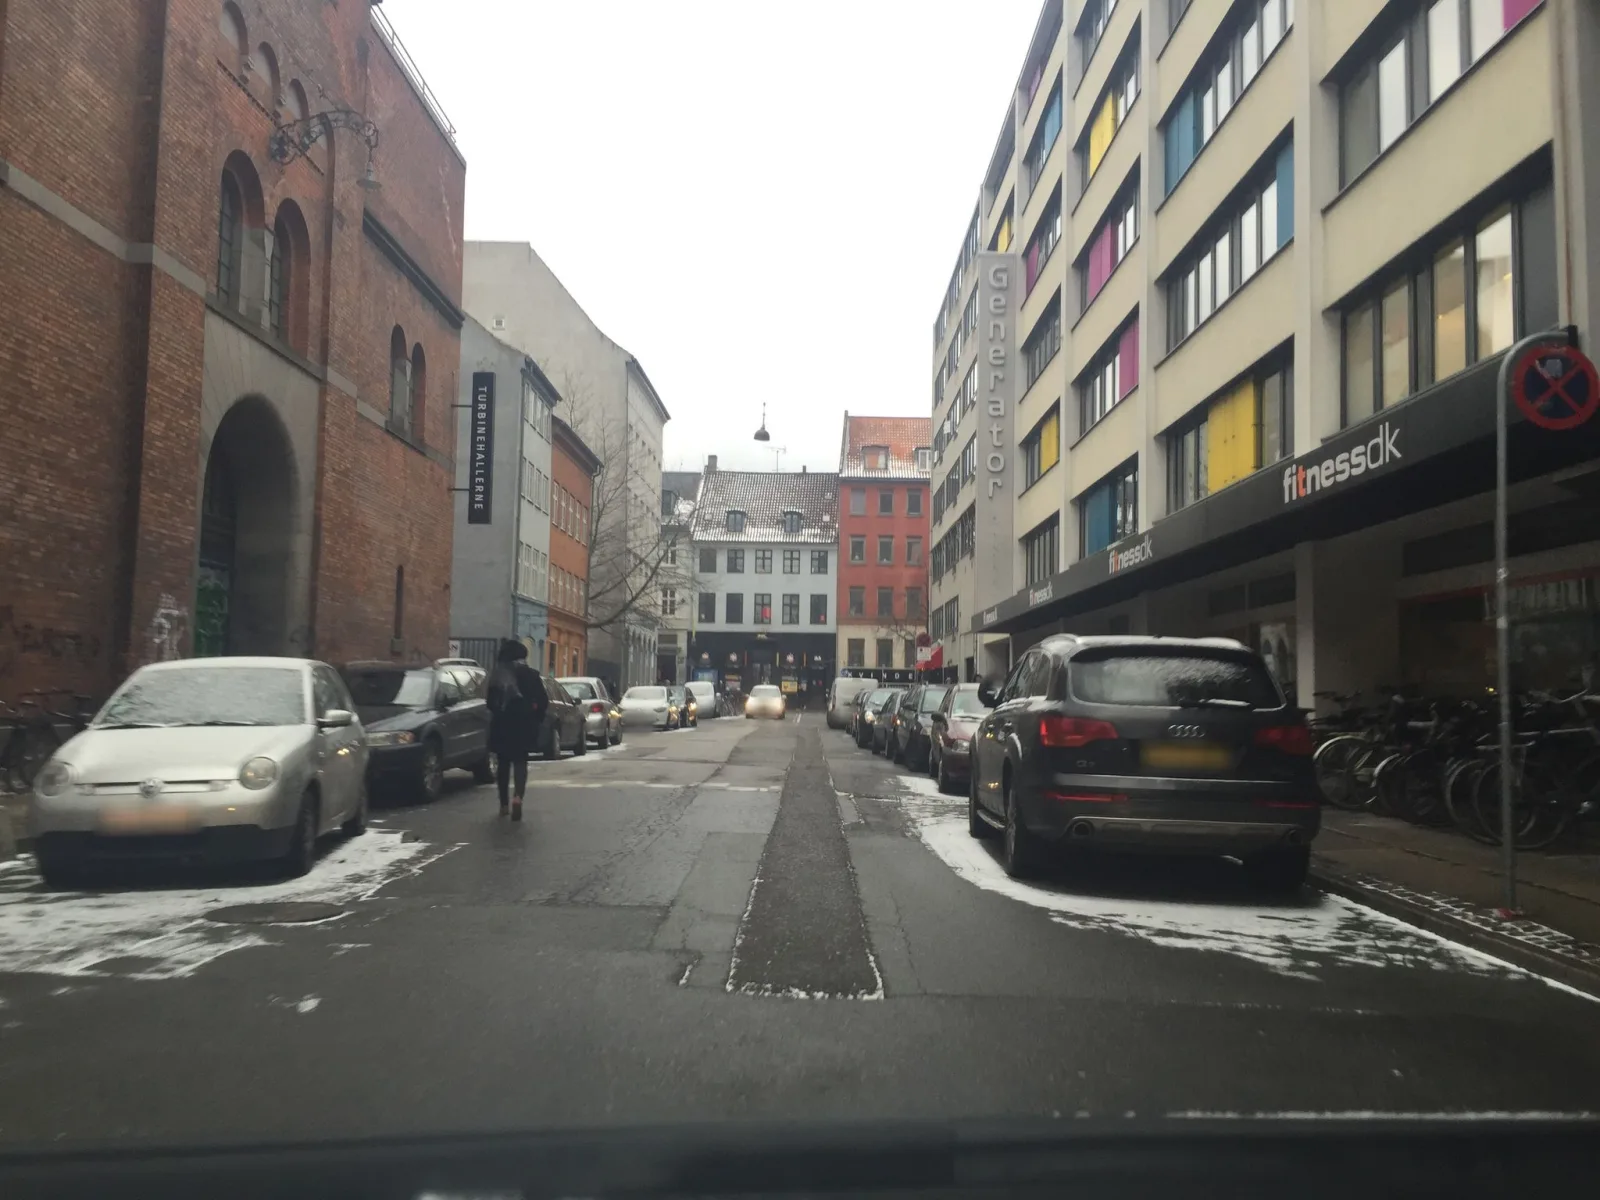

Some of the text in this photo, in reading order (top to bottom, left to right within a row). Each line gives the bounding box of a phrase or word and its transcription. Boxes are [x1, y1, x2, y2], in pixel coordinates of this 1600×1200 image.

[986, 264, 1008, 499] Generator
[474, 386, 487, 509] TURBINEHALLERNE
[1283, 421, 1402, 504] fitnessdk
[1109, 534, 1152, 575] fitnessdk
